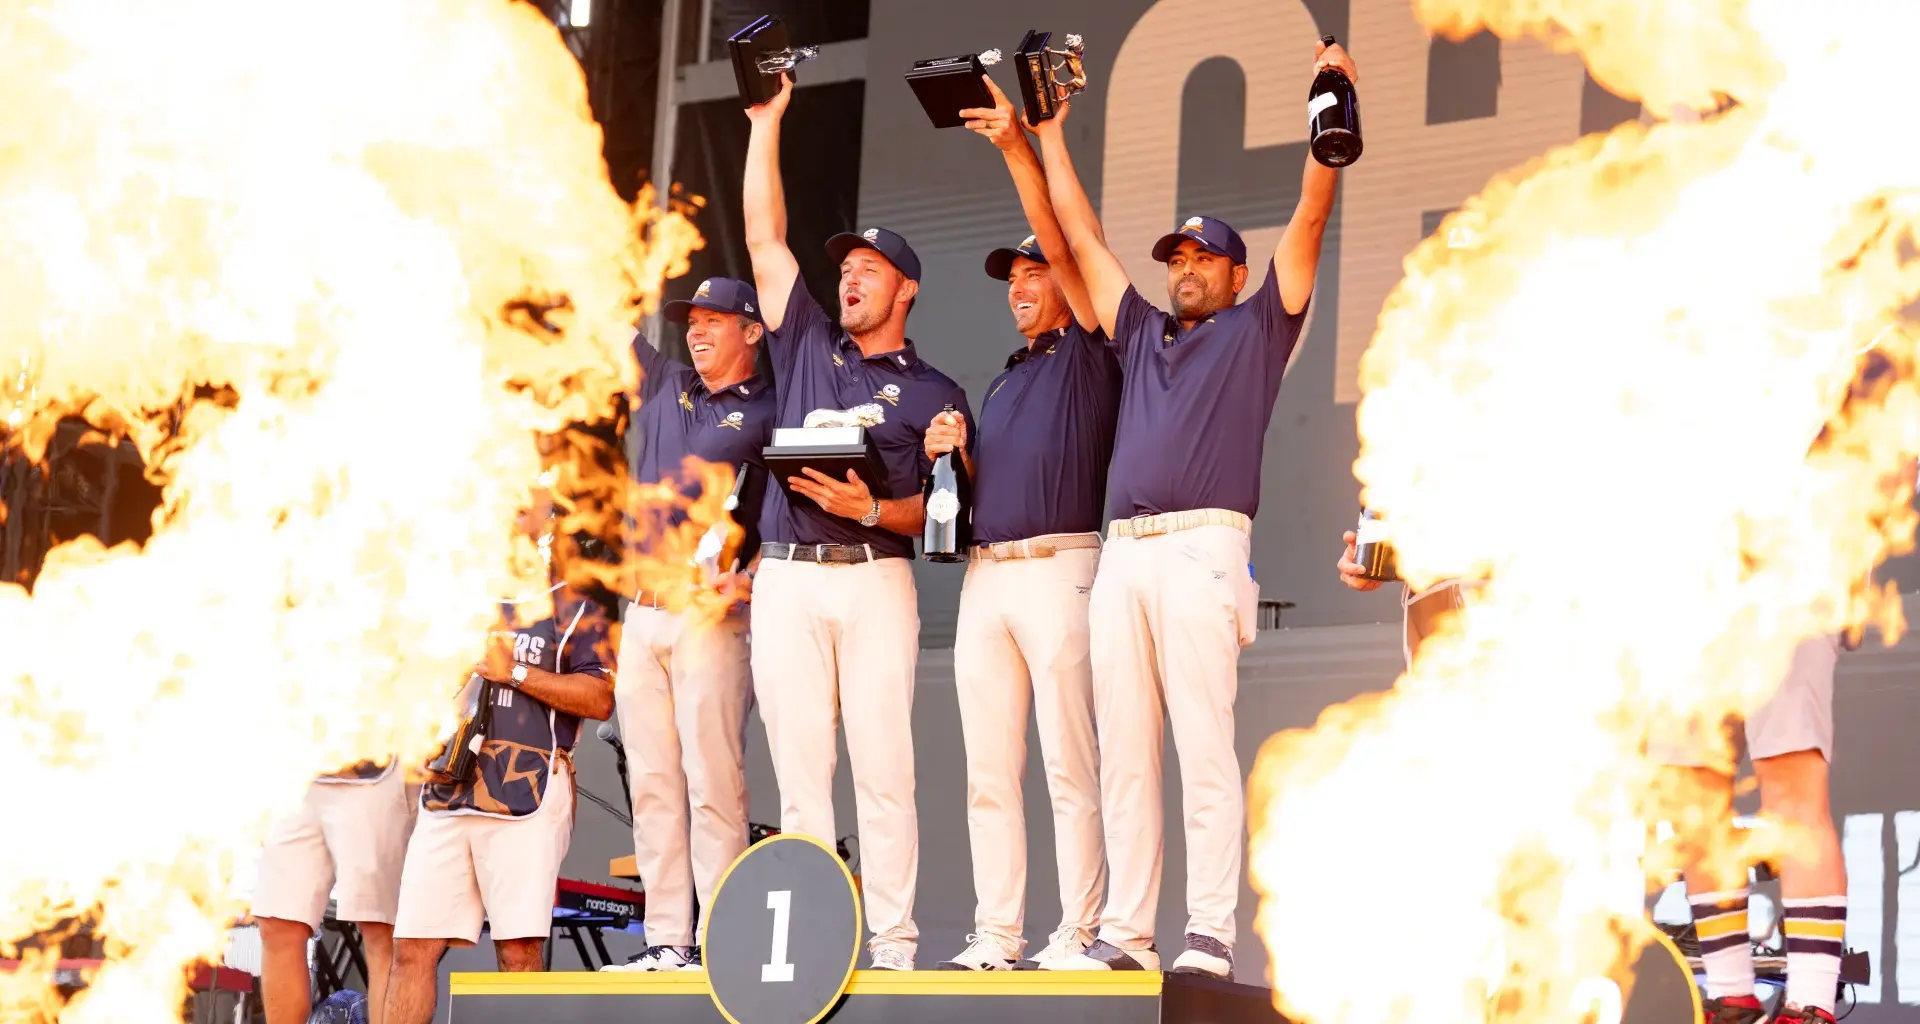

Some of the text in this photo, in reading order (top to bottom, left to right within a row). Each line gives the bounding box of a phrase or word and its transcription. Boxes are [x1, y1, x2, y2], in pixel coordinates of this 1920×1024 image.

[507, 631, 546, 665] RS
[586, 898, 635, 916] nord stage 3
[761, 890, 794, 982] 1
